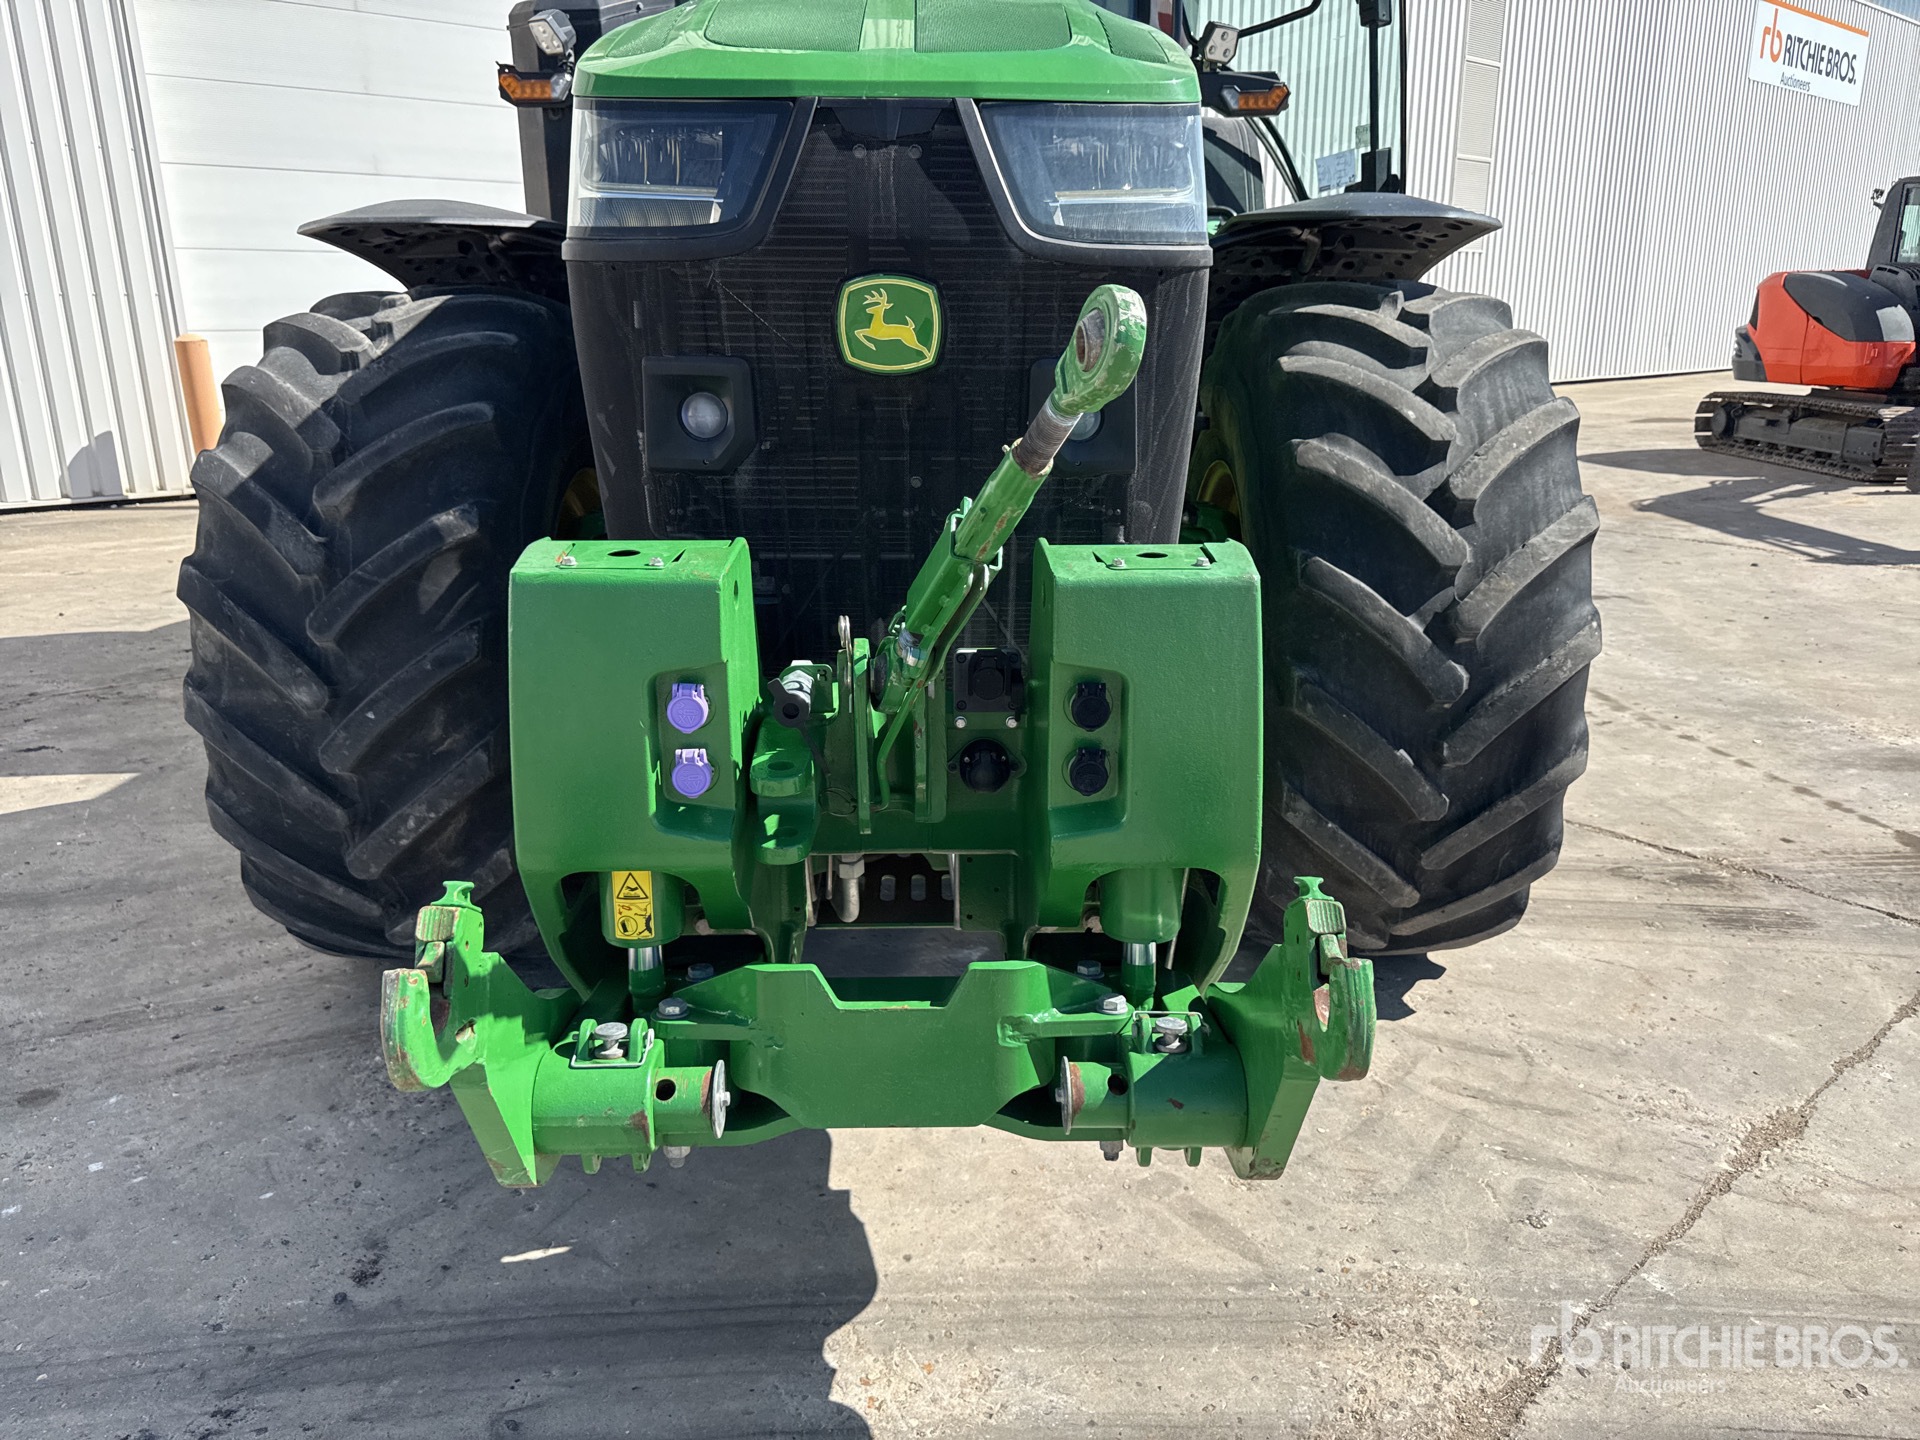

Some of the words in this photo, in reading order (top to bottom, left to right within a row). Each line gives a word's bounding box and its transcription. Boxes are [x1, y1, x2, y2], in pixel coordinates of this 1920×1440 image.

[1783, 34, 1826, 75] RITCHIE
[1825, 47, 1857, 85] BROS.
[1780, 72, 1811, 92] Auctioneers
